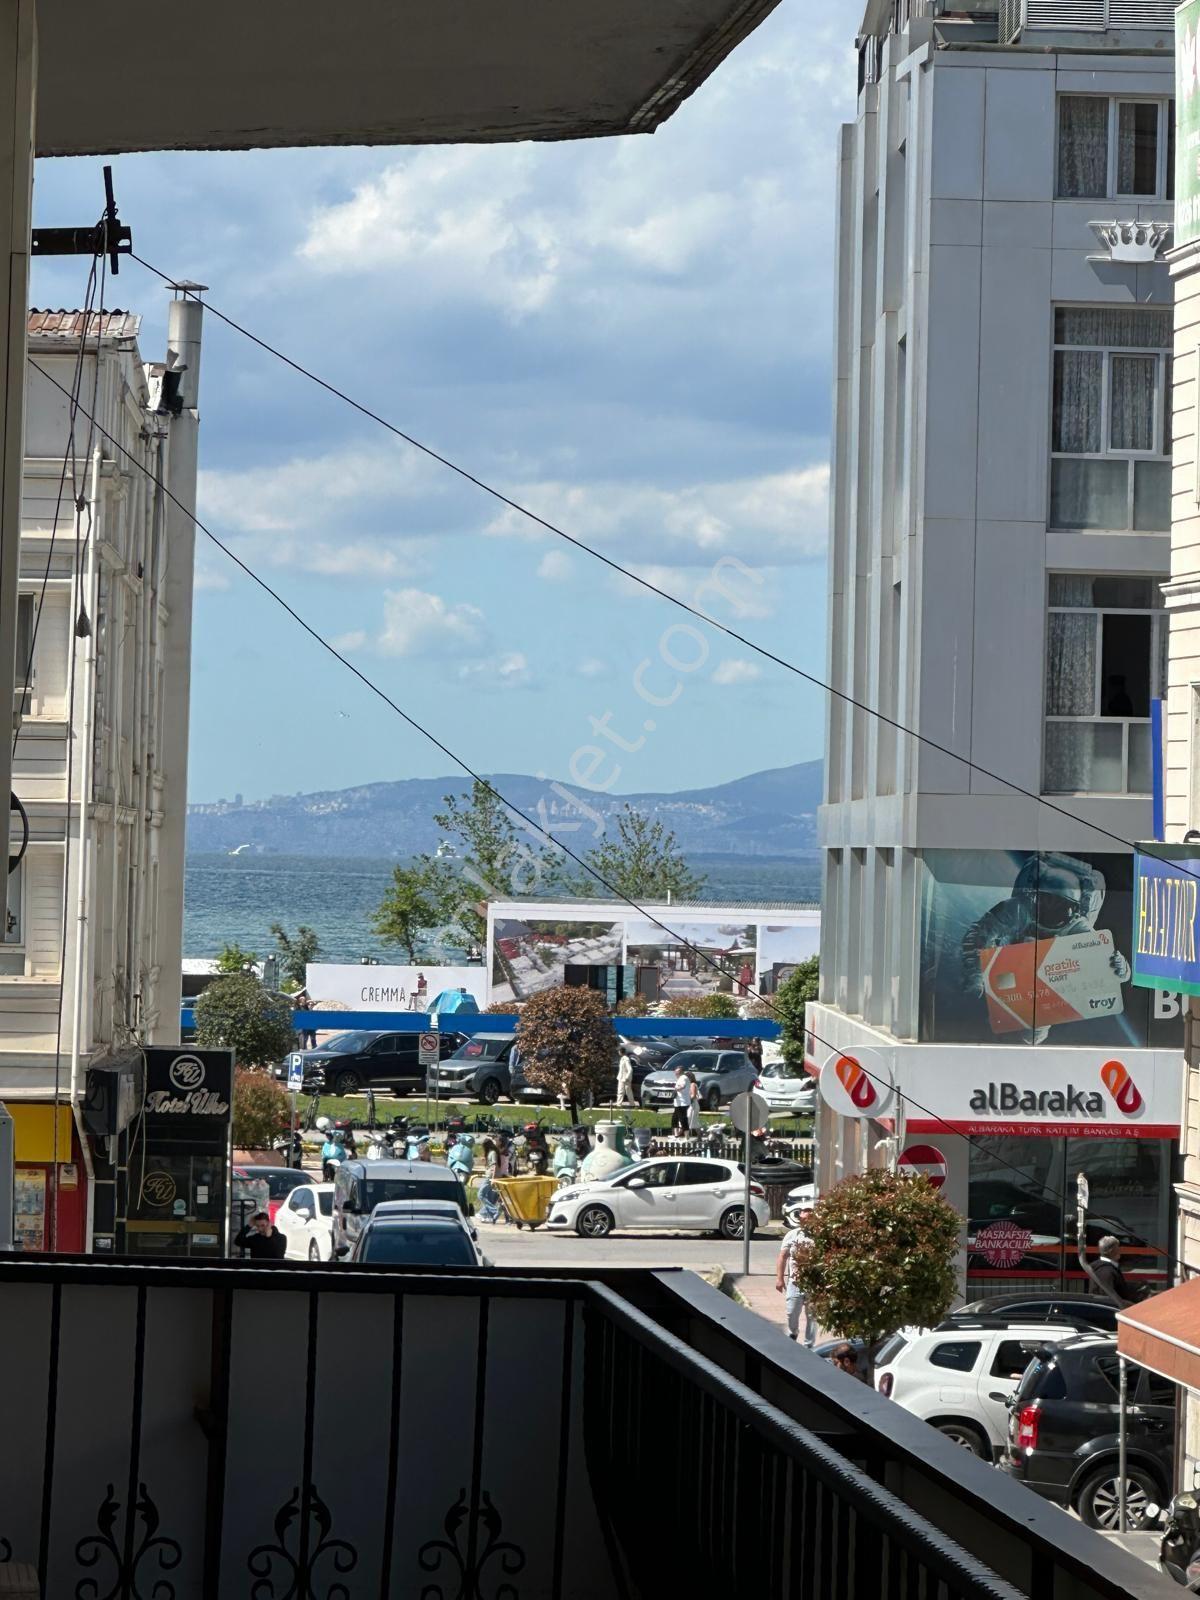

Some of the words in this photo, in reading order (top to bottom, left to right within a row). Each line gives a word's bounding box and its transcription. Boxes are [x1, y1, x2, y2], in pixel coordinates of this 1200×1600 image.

[361, 986, 406, 1002] CREMMA
[1089, 997, 1116, 1009] troy
[292, 1054, 302, 1072] P
[969, 1082, 1103, 1113] alBaraka
[968, 1126, 1015, 1134] ALBARAKA
[975, 1240, 1033, 1249] BANKACILIK
